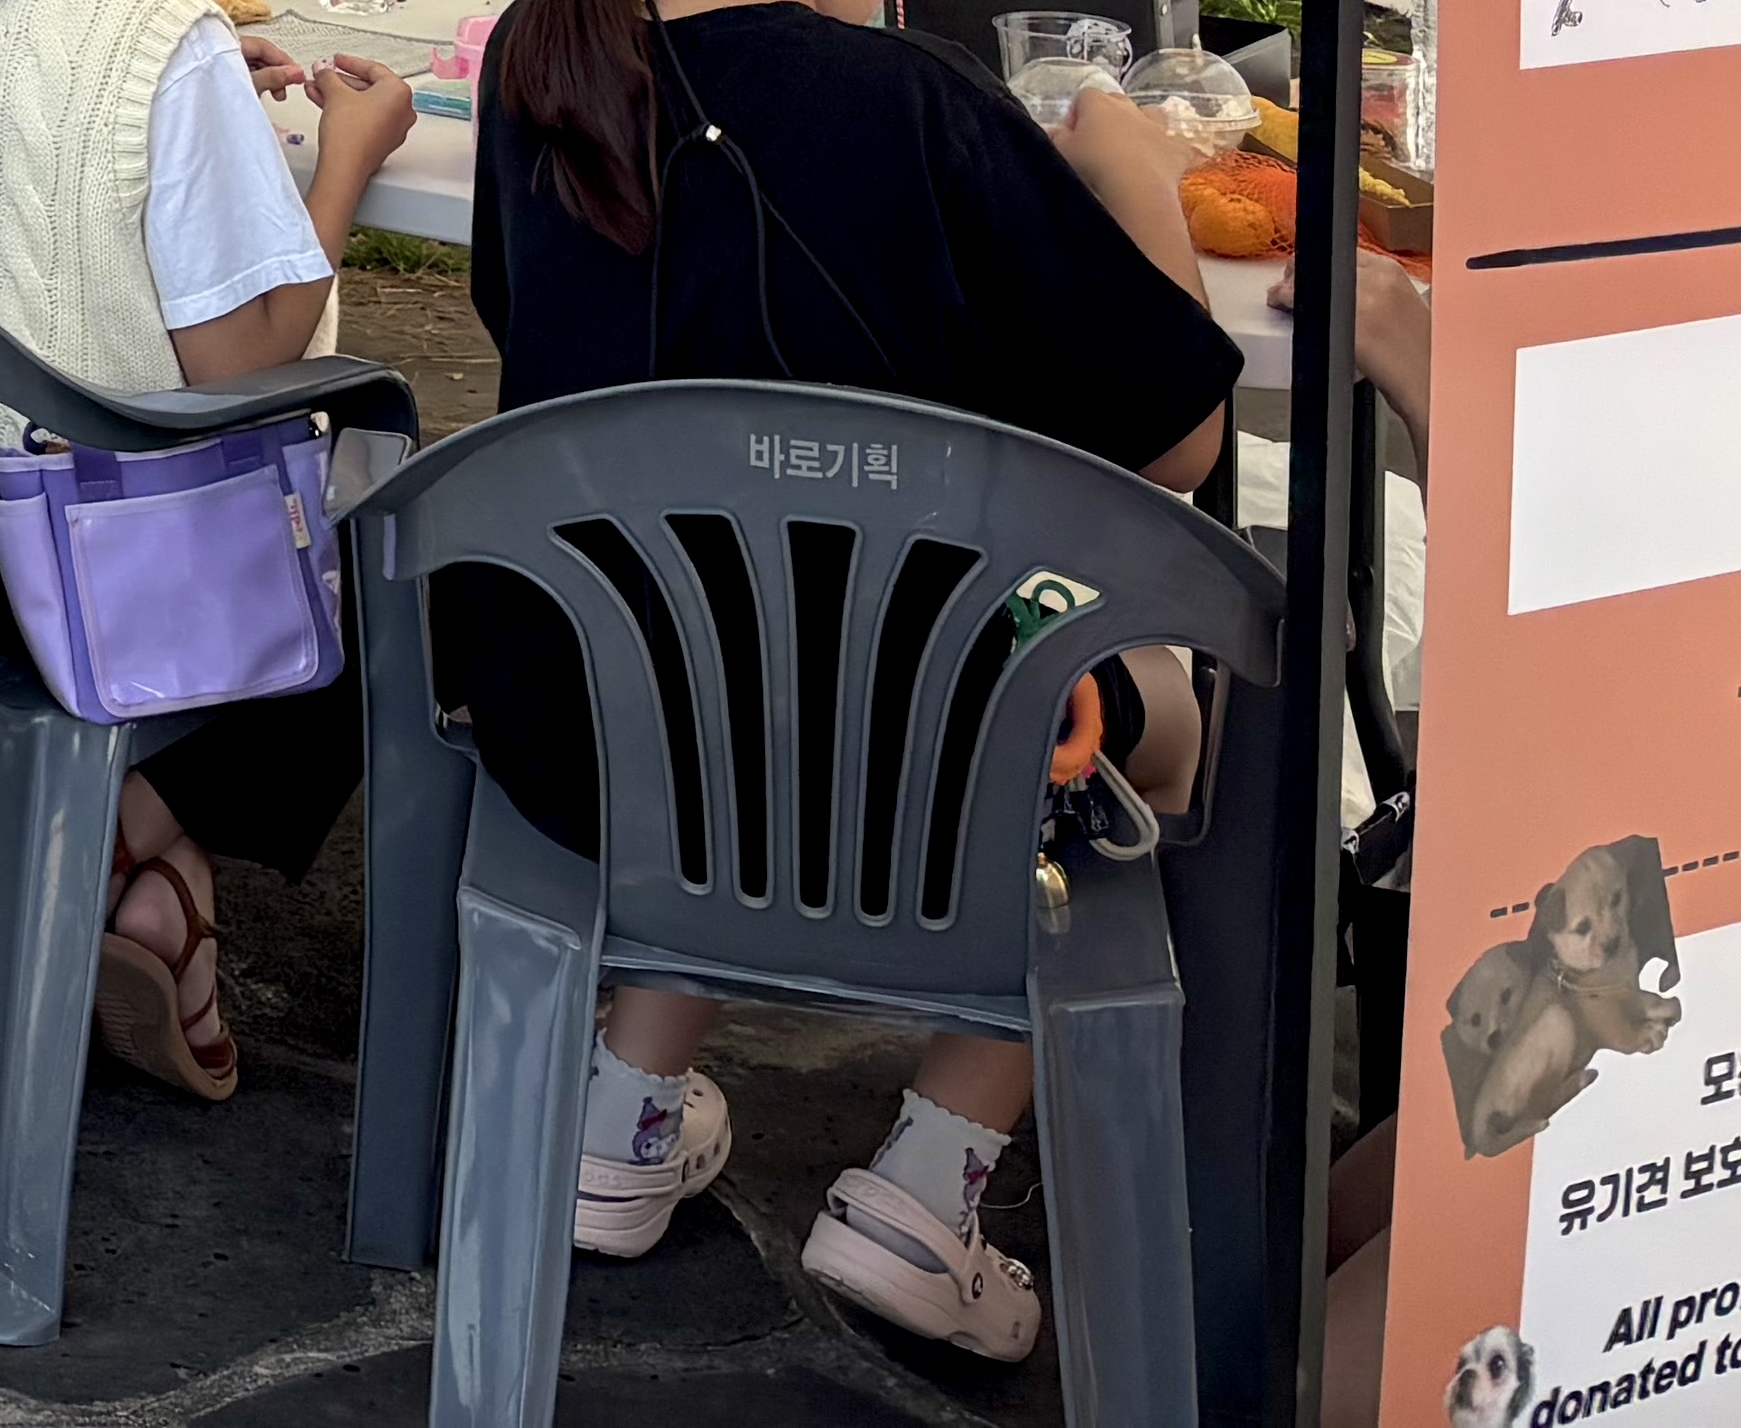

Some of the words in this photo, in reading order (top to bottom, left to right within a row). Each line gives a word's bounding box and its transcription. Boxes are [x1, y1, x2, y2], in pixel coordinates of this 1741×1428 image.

[749, 433, 898, 490] 바로기획
[1700, 1051, 1741, 1106] 모
[1559, 1156, 1671, 1236] 유기견
[1602, 1295, 1664, 1353] All
[1666, 1281, 1741, 1341] pro
[1529, 1339, 1708, 1428] donated
